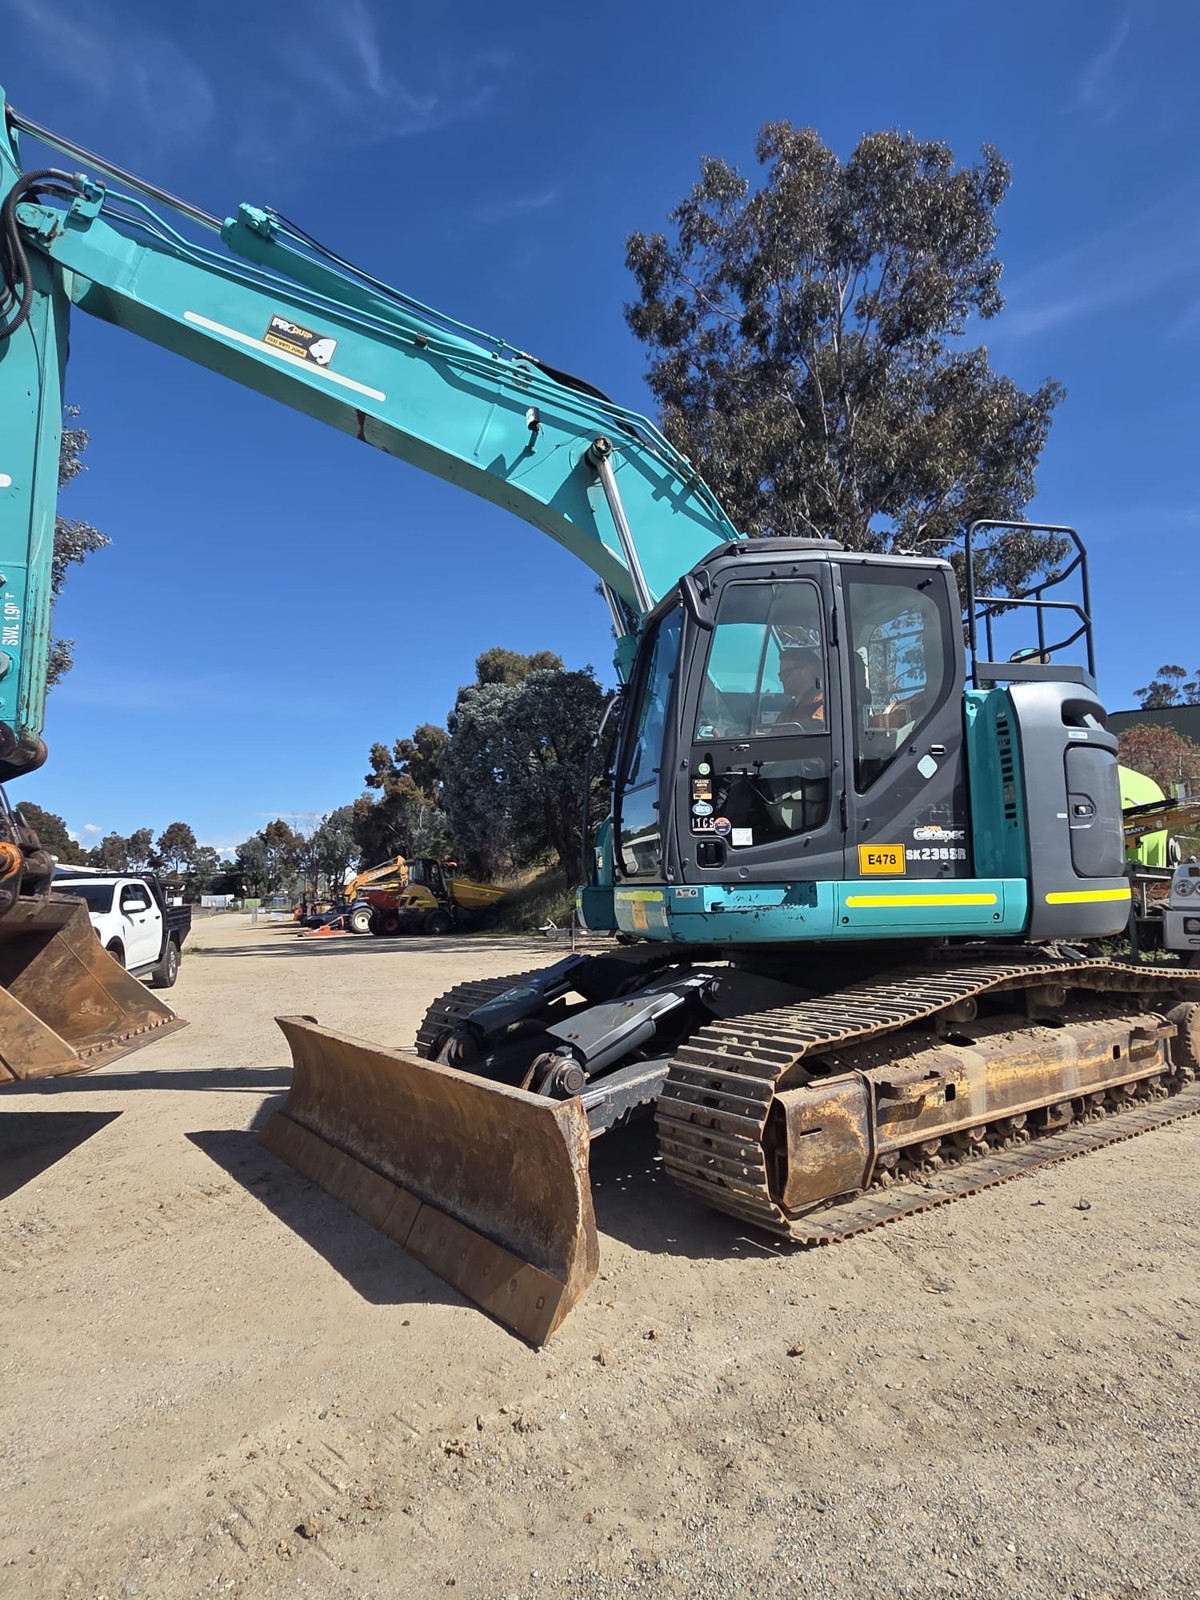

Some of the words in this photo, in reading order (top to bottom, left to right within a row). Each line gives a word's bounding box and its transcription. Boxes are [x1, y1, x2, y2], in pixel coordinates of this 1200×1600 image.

[2, 624, 20, 646] SWL
[913, 828, 965, 842] Geospec
[1125, 826, 1146, 835] SANY
[867, 854, 897, 865] E478
[906, 848, 966, 860] SK235SR
